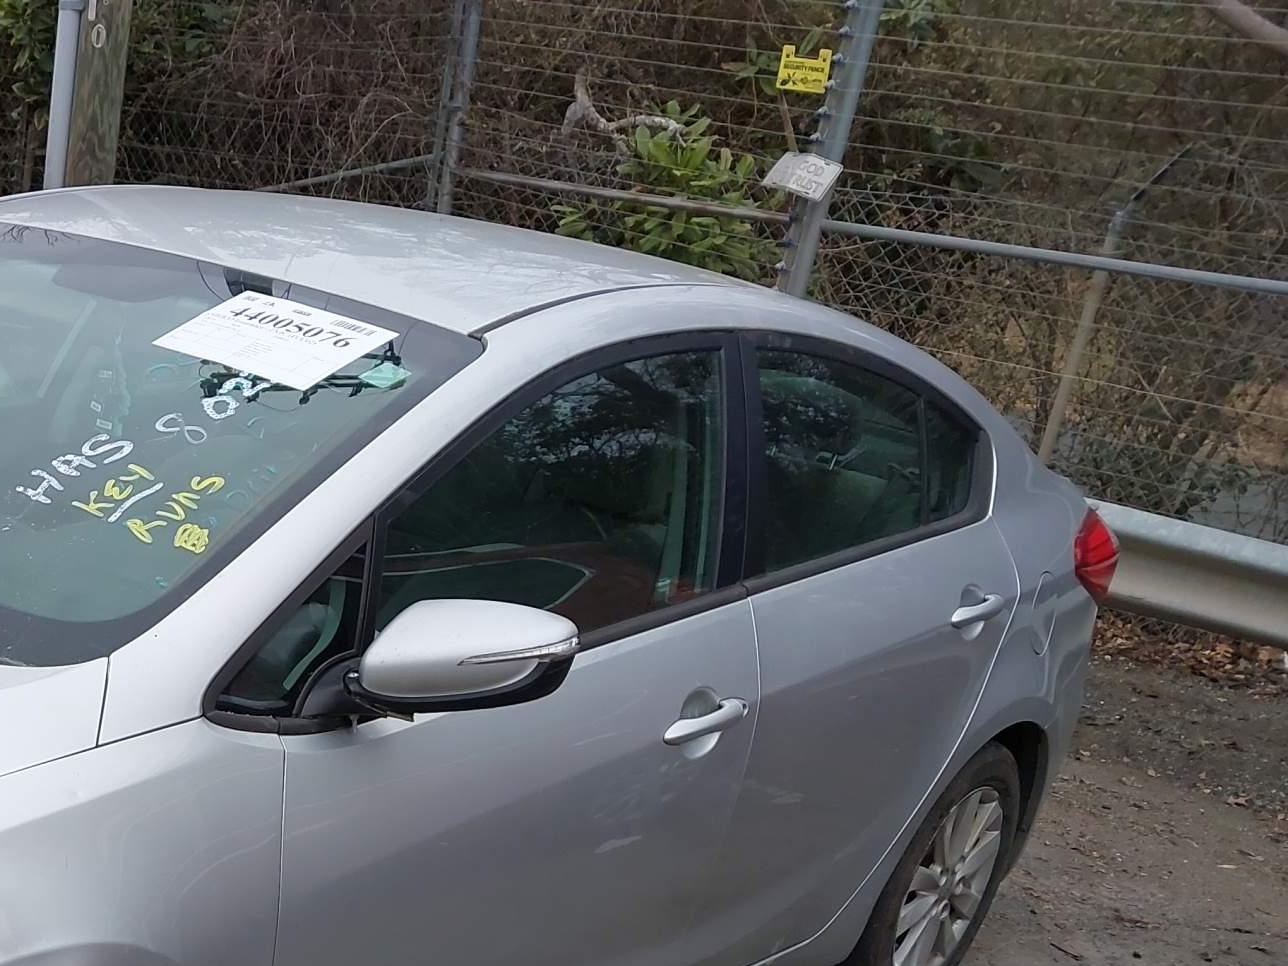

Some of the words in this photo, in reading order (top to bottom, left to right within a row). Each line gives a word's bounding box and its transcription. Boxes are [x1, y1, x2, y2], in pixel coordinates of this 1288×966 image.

[229, 307, 357, 349] 44005076
[15, 433, 134, 504] HAS
[71, 463, 156, 518] KEY
